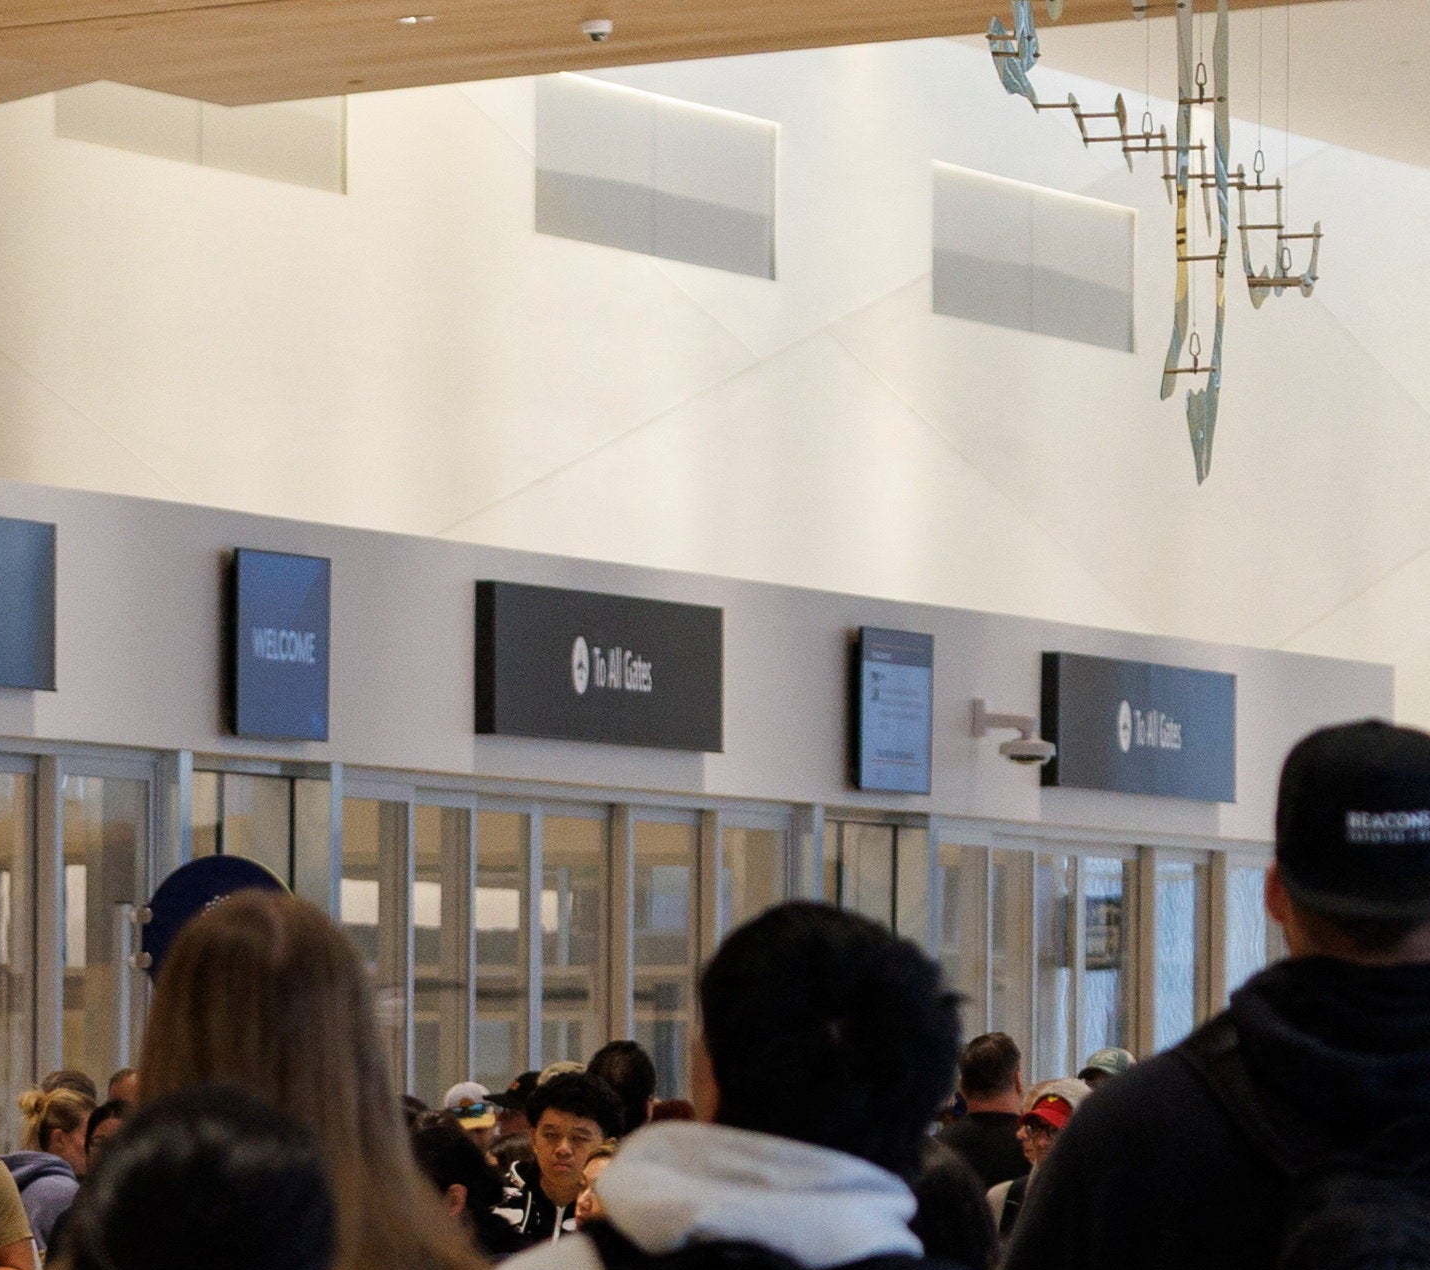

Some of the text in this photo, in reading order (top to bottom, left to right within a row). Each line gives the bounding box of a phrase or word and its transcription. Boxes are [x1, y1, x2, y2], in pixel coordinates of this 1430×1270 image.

[251, 626, 317, 664] WELCOME
[592, 646, 653, 693] To All Gates
[1159, 712, 1182, 750] Gates
